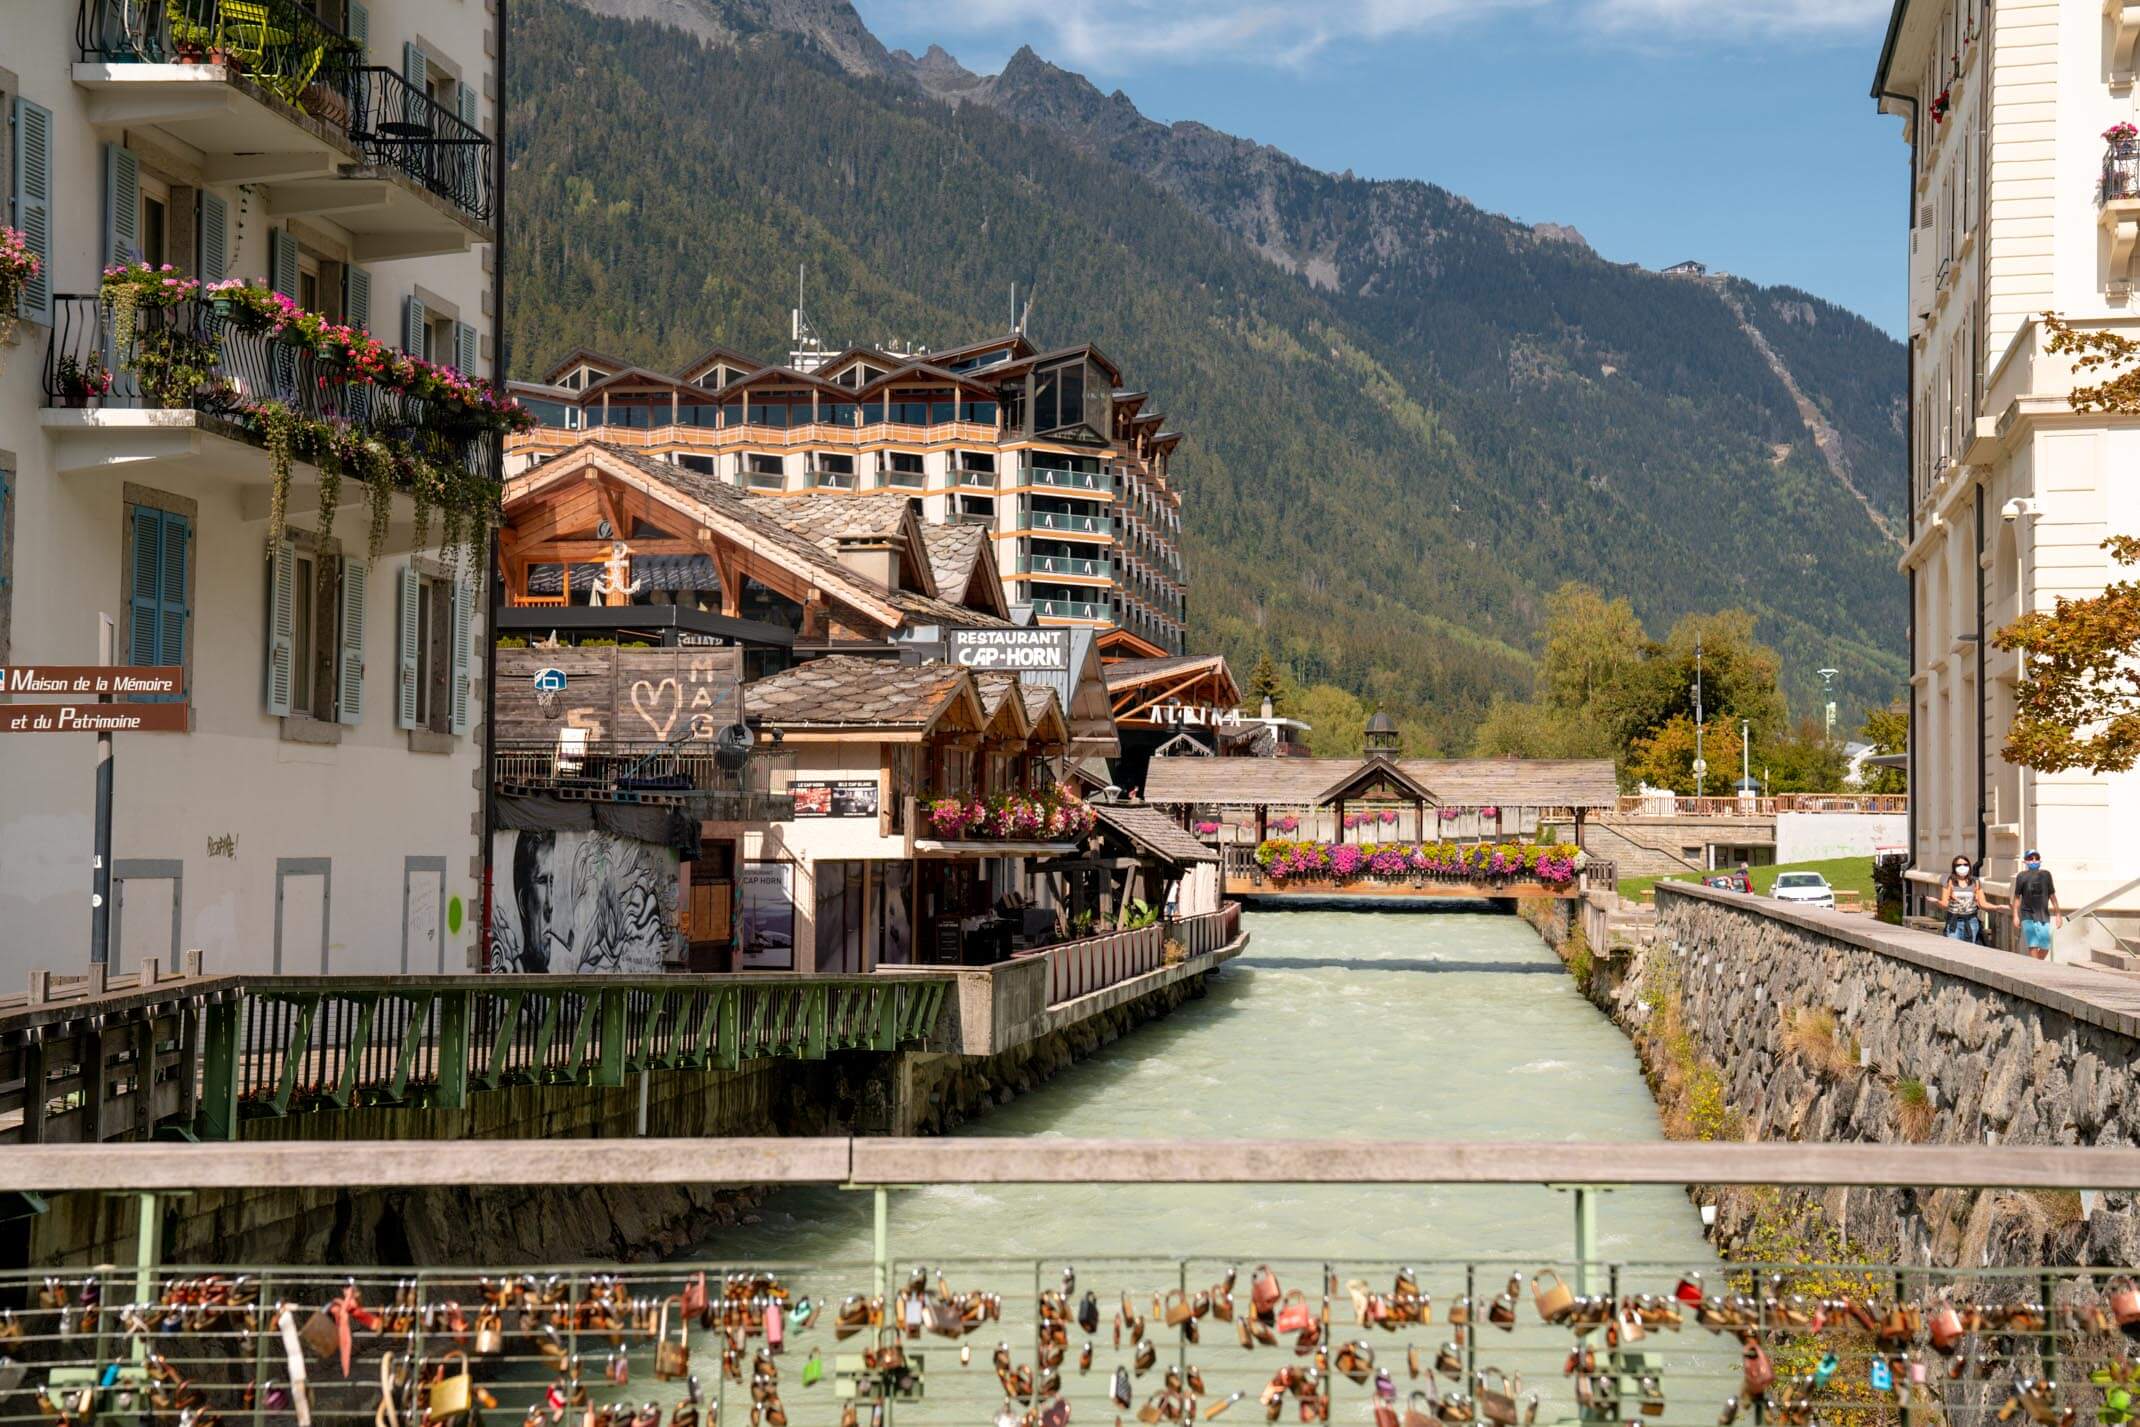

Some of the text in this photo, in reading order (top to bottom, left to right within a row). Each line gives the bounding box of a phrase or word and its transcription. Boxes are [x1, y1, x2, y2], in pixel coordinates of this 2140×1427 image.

[957, 631, 1061, 645] RESTAURANT
[958, 647, 1061, 666] CAP-HORN
[11, 669, 173, 691] Maison de la Mémoire
[11, 707, 141, 729] et du Patrimoine
[743, 876, 782, 885] CAP HORN
